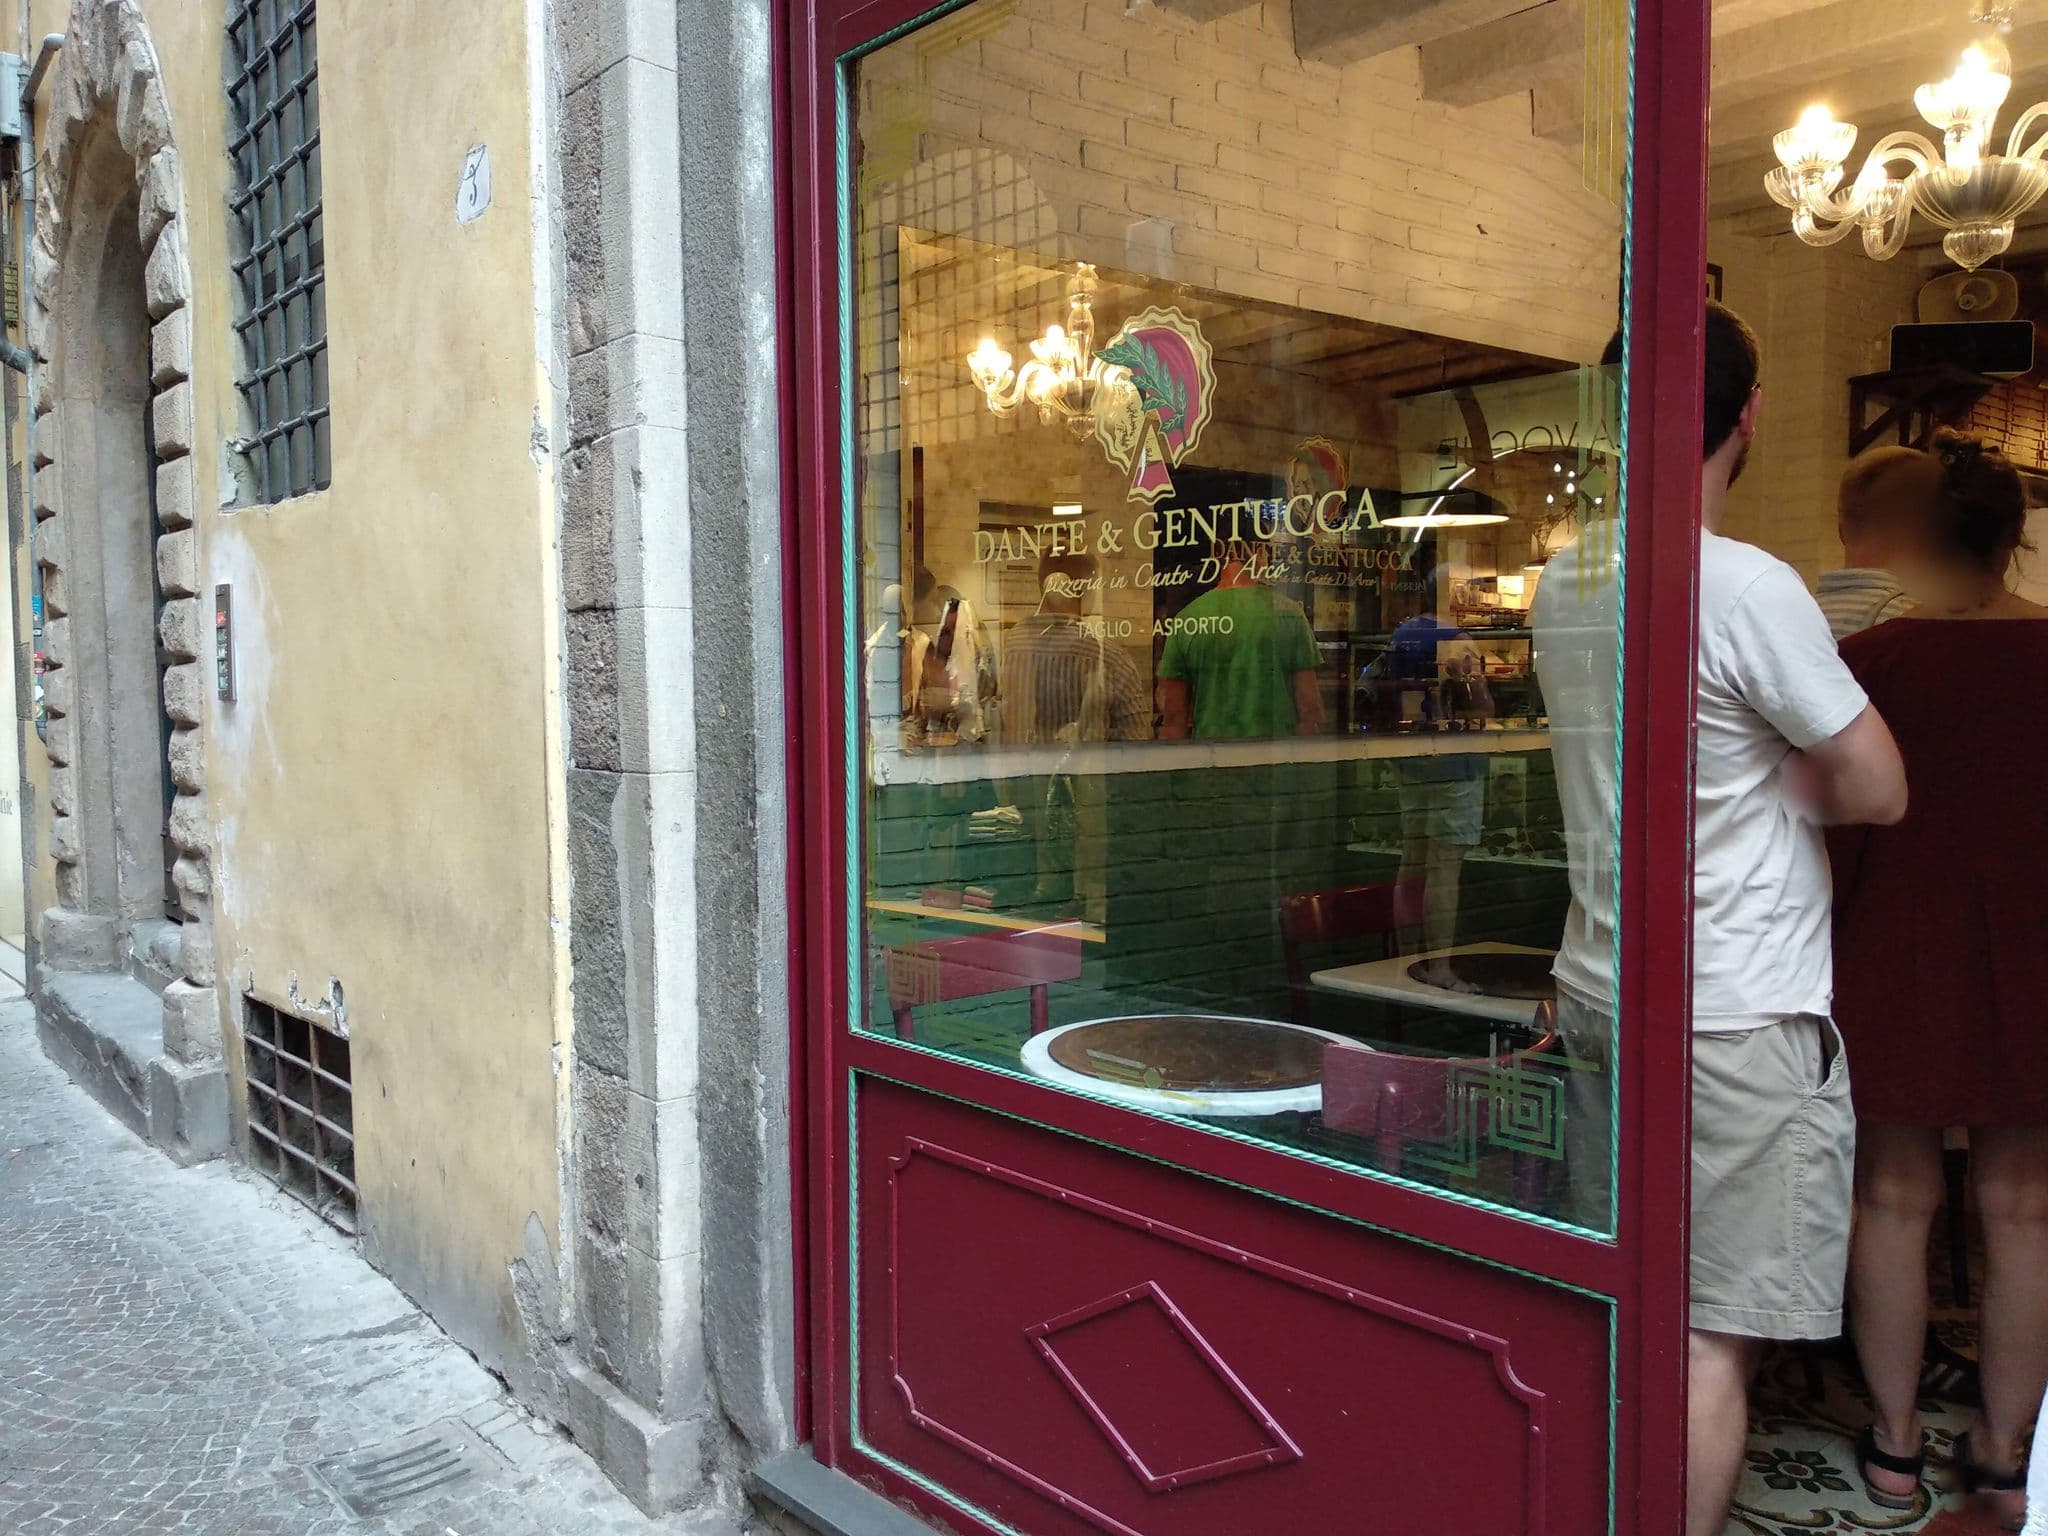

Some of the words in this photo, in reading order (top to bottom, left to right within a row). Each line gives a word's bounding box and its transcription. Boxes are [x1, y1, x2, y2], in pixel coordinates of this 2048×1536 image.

[972, 519, 1089, 564] DANTE
[1096, 520, 1123, 554] &
[1132, 487, 1384, 551] GENTUCCA
[1307, 545, 1415, 572] GENTUCCA
[1109, 569, 1129, 590] in
[1134, 562, 1194, 588] Canto
[1076, 619, 1133, 639] TAGLIO
[1152, 615, 1235, 637] ASPORTO
